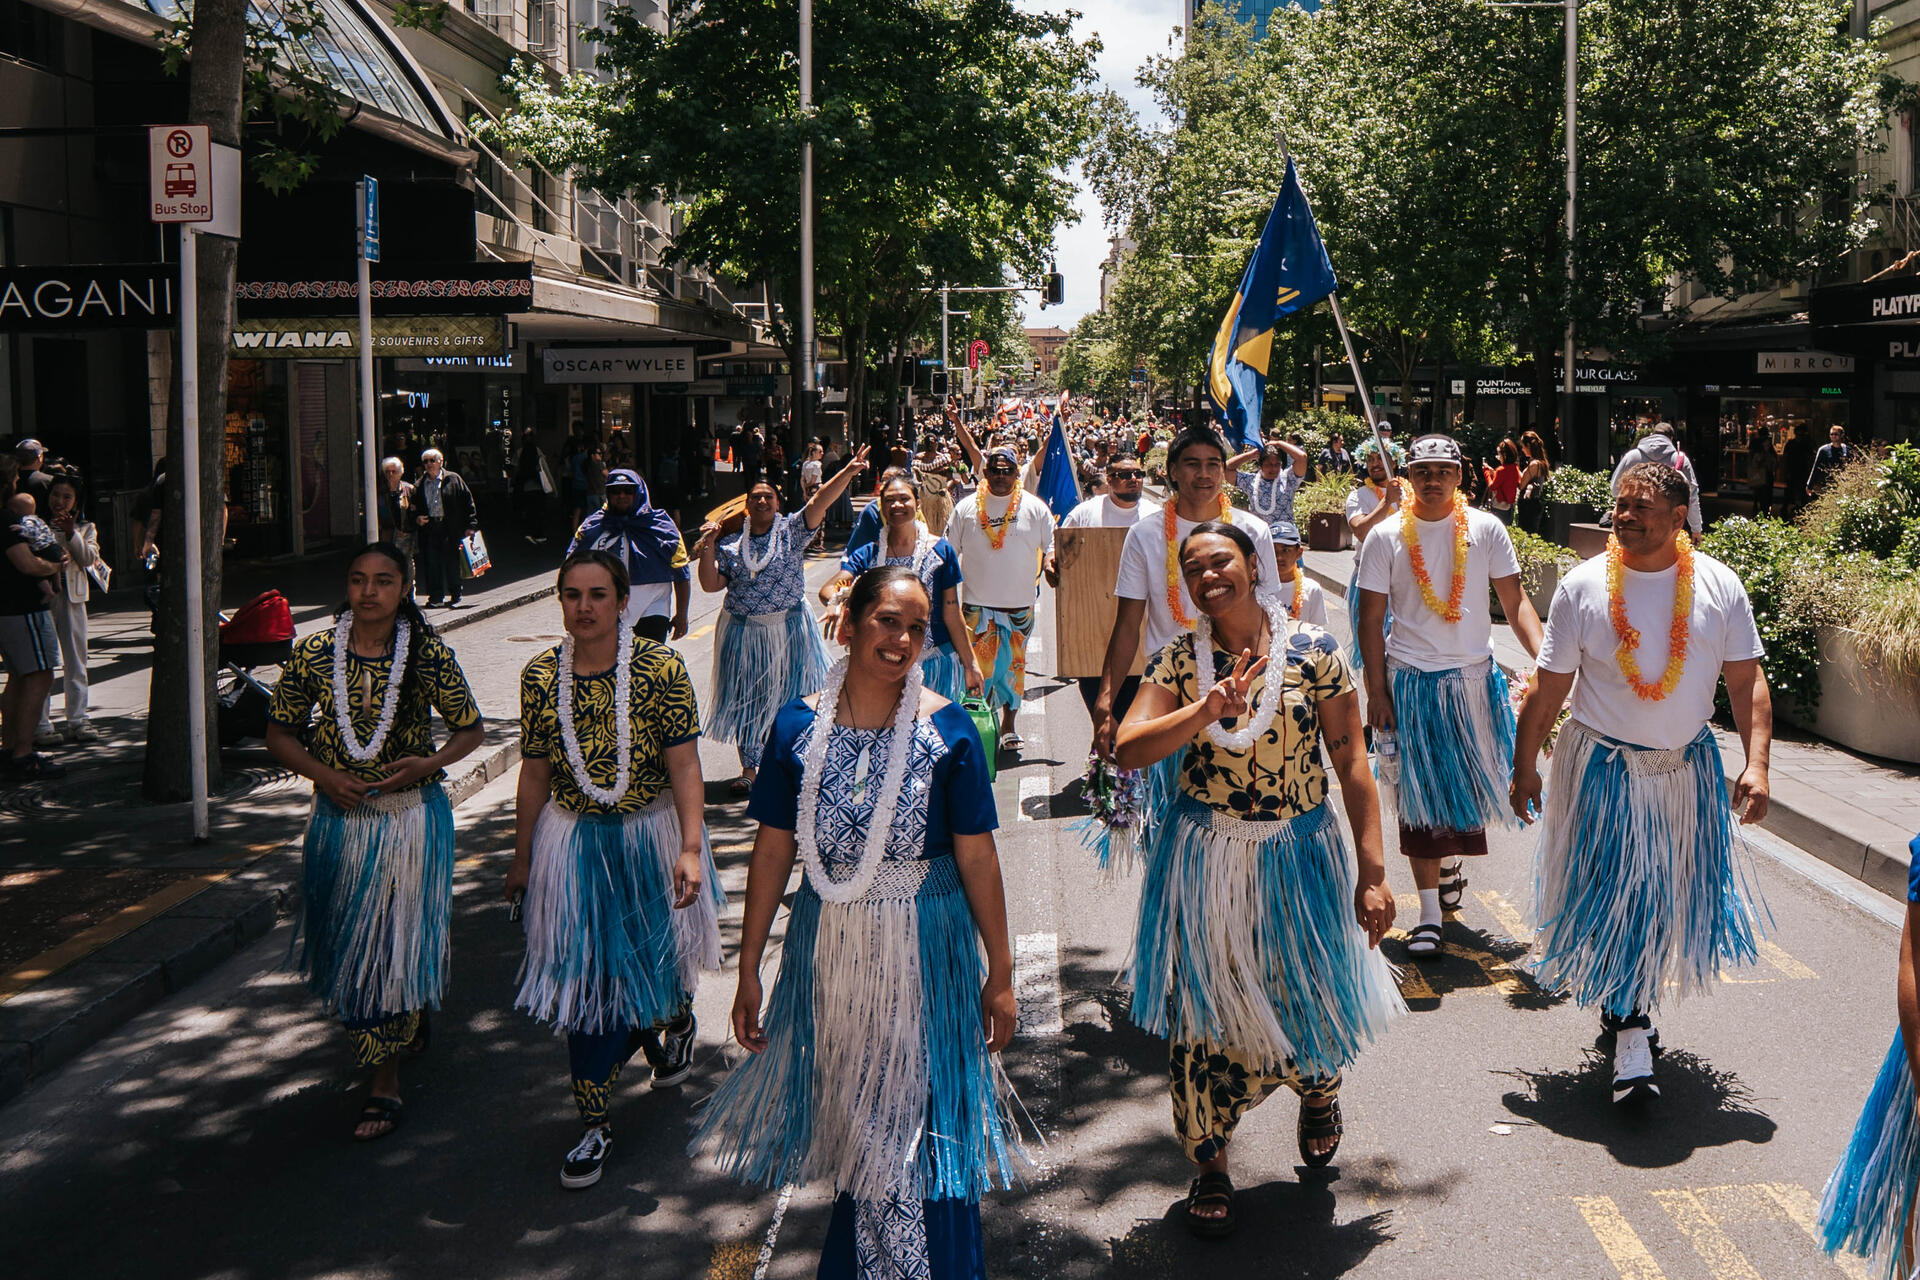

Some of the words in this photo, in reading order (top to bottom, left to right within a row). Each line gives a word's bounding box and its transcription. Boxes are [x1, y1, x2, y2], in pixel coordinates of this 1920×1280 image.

[154, 202, 178, 215] Bus
[180, 202, 209, 217] Stop
[0, 278, 172, 318] AGANI
[1873, 294, 1920, 316] PLATYP
[232, 331, 354, 348] WIANA
[379, 336, 440, 346] SOUVENIRS
[443, 336, 450, 346] &
[454, 336, 485, 346] GIFTS
[552, 359, 613, 372] OSCAR
[625, 359, 686, 371] WYLEE
[1764, 357, 1848, 369] MIRROU
[1476, 379, 1521, 387] OUNTAIN
